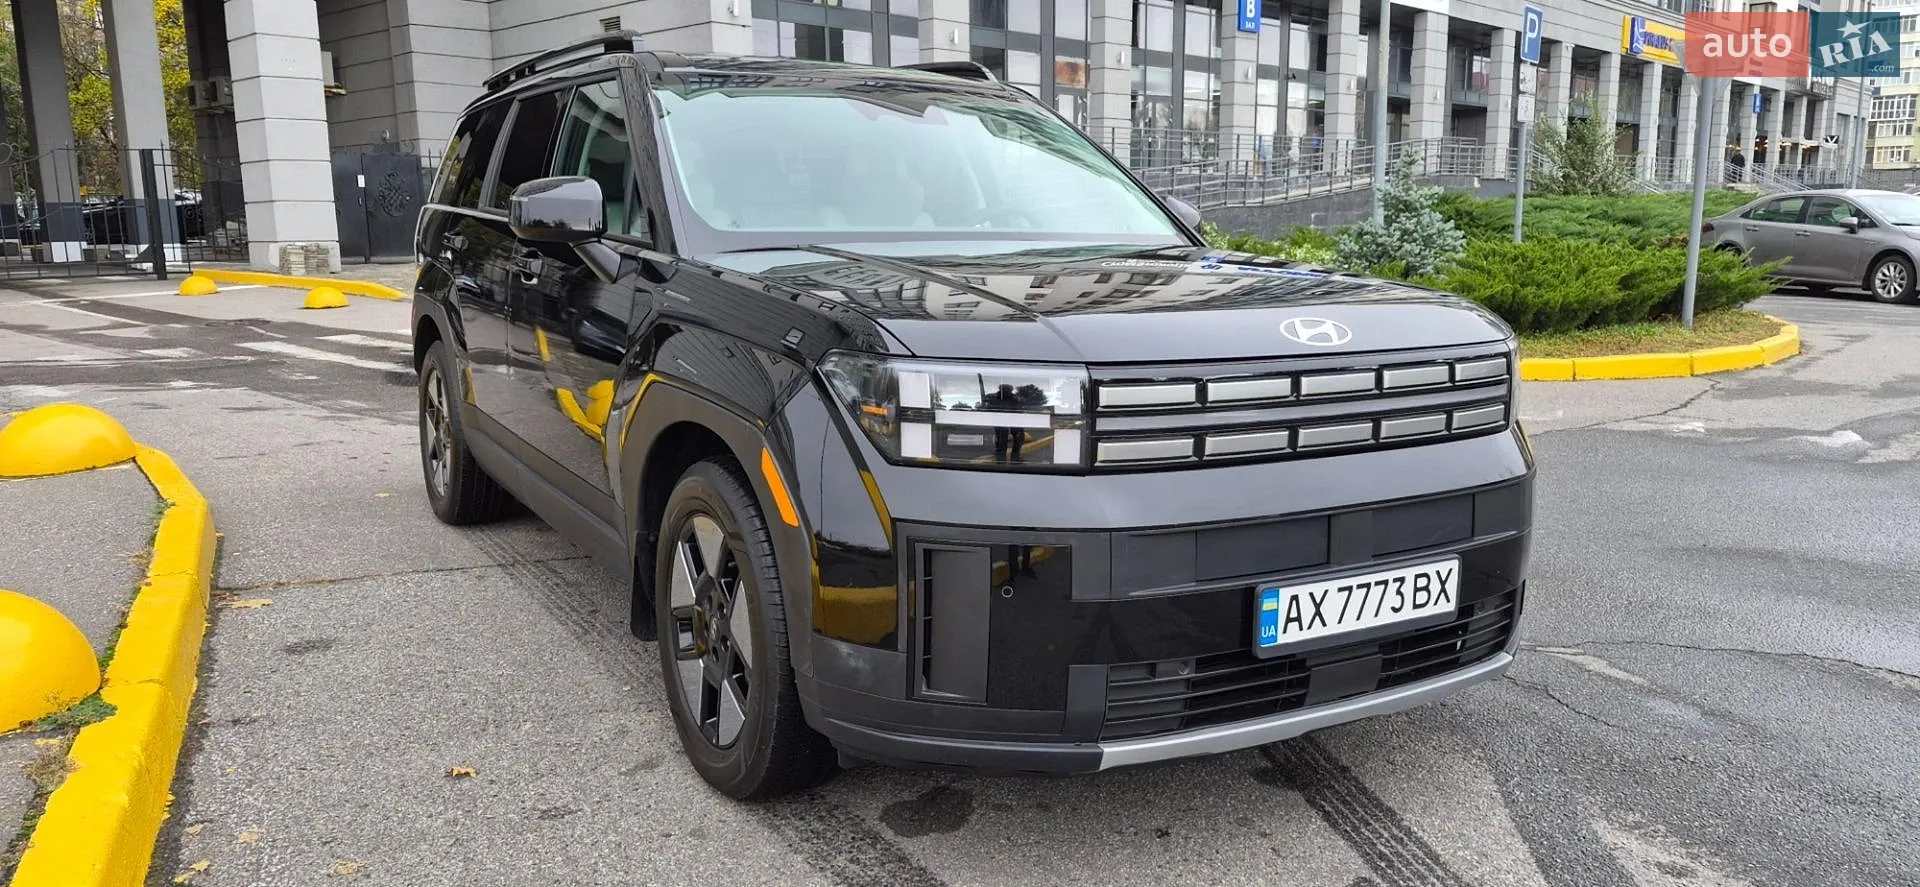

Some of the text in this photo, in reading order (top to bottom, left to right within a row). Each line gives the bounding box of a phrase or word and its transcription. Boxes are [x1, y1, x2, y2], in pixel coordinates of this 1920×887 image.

[1524, 12, 1539, 53] P
[1282, 567, 1453, 634] AX 7773 BX
[1261, 627, 1276, 638] UA
